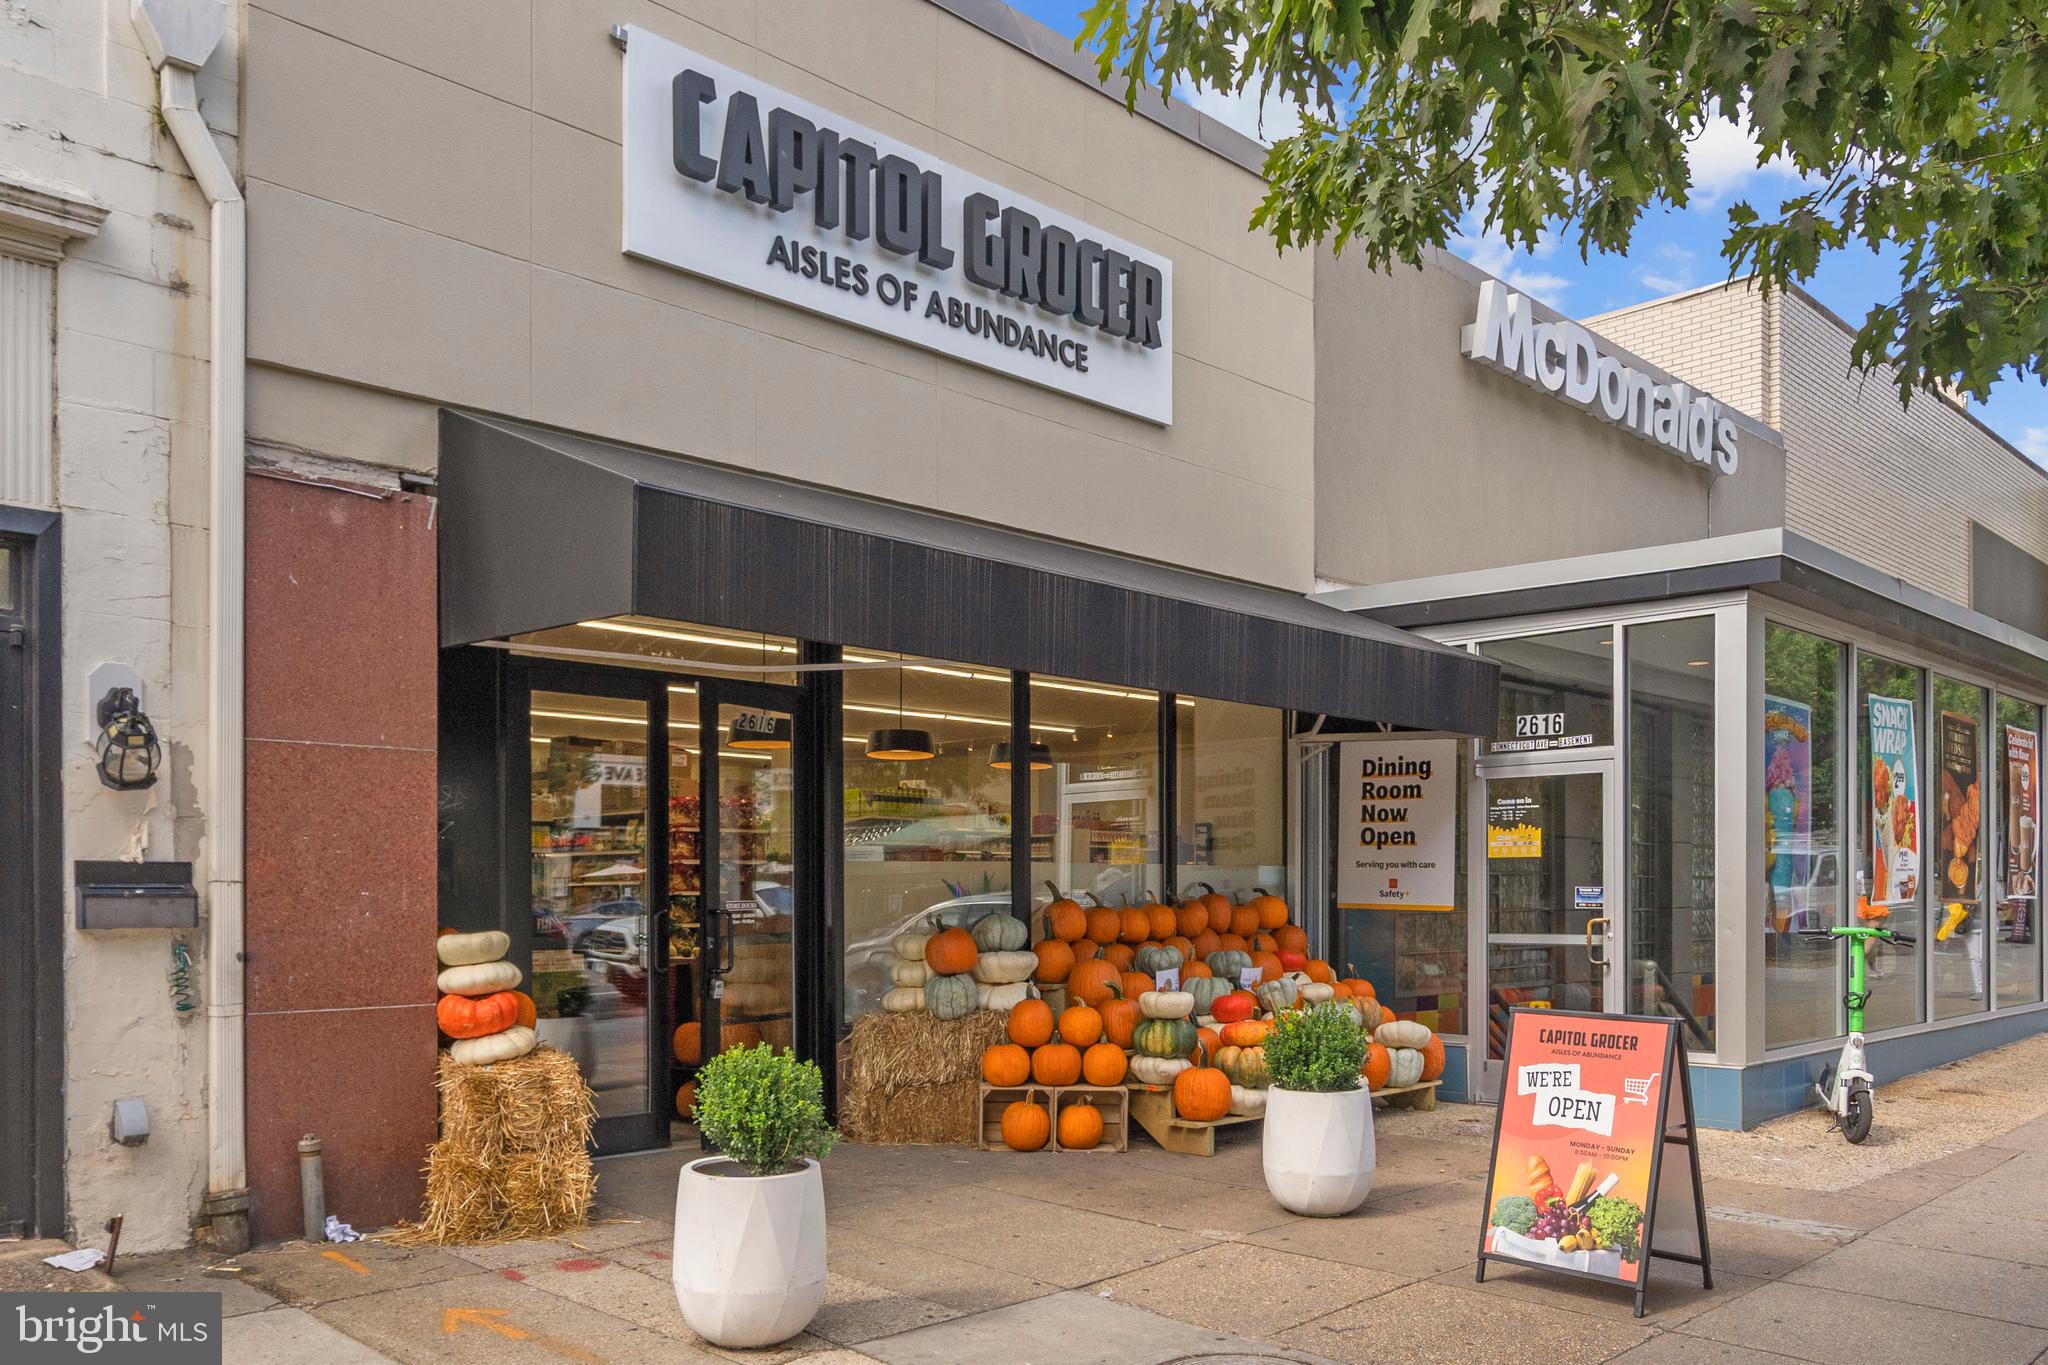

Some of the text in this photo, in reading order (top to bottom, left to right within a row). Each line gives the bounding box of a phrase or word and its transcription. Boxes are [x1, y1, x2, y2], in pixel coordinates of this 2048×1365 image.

[673, 69, 1162, 349] CAPITOL GROCER
[767, 236, 1088, 372] AISLES OF ABUNDANCE
[1471, 280, 1738, 475] McDonald's
[739, 713, 774, 732] 2616
[1518, 714, 1562, 736] 2616
[1873, 703, 1908, 730] SNACK
[1491, 741, 1534, 751] CONNECTICUT
[1536, 739, 1549, 750] AVE
[1559, 734, 1593, 747] BASEMENT
[1873, 727, 1907, 756] WRAP
[1362, 755, 1431, 780] Dining
[1361, 782, 1422, 799] Room
[1361, 805, 1408, 822] Now
[1360, 827, 1416, 850] Open
[1355, 861, 1384, 871] Serving
[1385, 862, 1399, 871] you
[1400, 860, 1417, 869] with
[1539, 1028, 1638, 1051] CAPITOL GROCER
[1551, 1048, 1571, 1056] AISLES
[1582, 1051, 1622, 1061] ABUNDANCE
[1527, 1070, 1572, 1087] WE'RE
[1548, 1096, 1602, 1122] OPEN
[1569, 1140, 1600, 1150] MONDAY
[1607, 1145, 1636, 1155] SUNDAY
